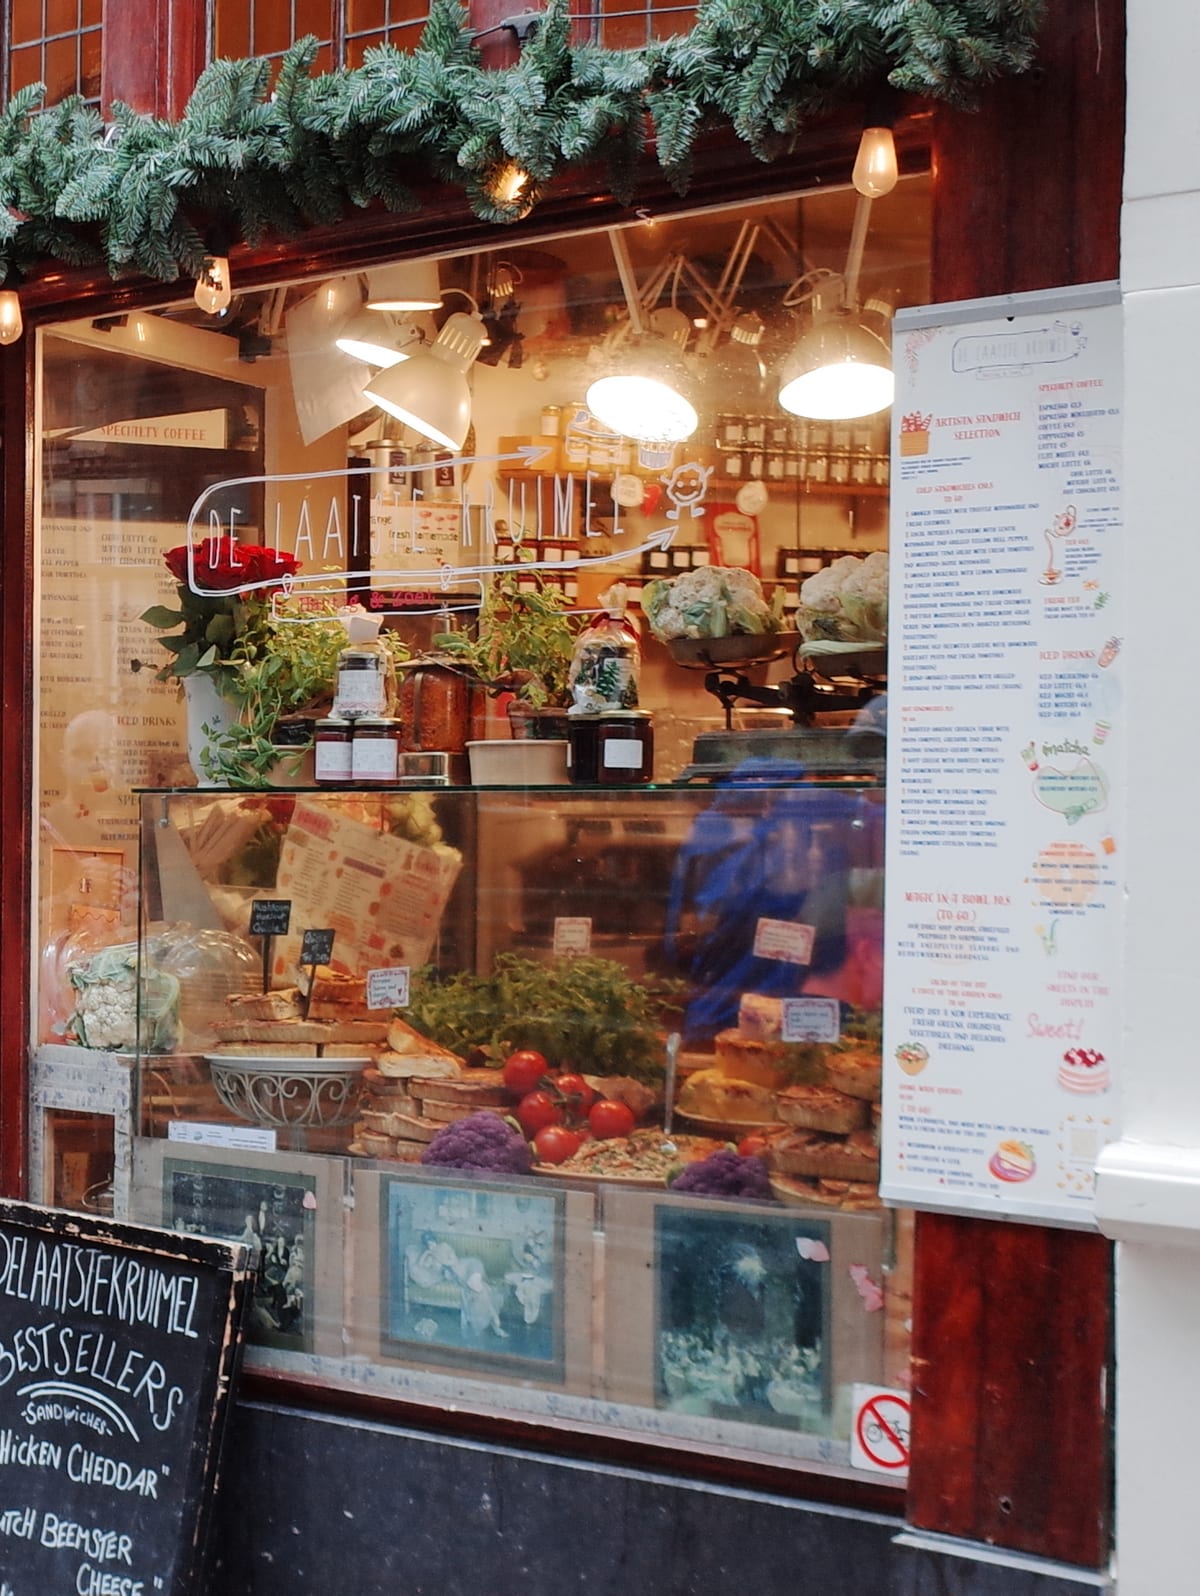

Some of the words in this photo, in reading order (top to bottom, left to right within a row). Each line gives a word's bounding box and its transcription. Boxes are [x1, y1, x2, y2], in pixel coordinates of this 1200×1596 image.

[976, 411, 1021, 425] SANDWICH
[99, 423, 159, 439] SPECIALTY
[163, 427, 207, 442] COFFEE
[954, 428, 1001, 440] SELECTION
[208, 507, 245, 571] DE
[274, 487, 426, 564] LAATSTE
[460, 466, 626, 549] KRUIMEL
[142, 714, 178, 728] DRINKS
[1027, 1012, 1085, 1041] Sweet!
[40, 1513, 134, 1566] BEEMSTER
